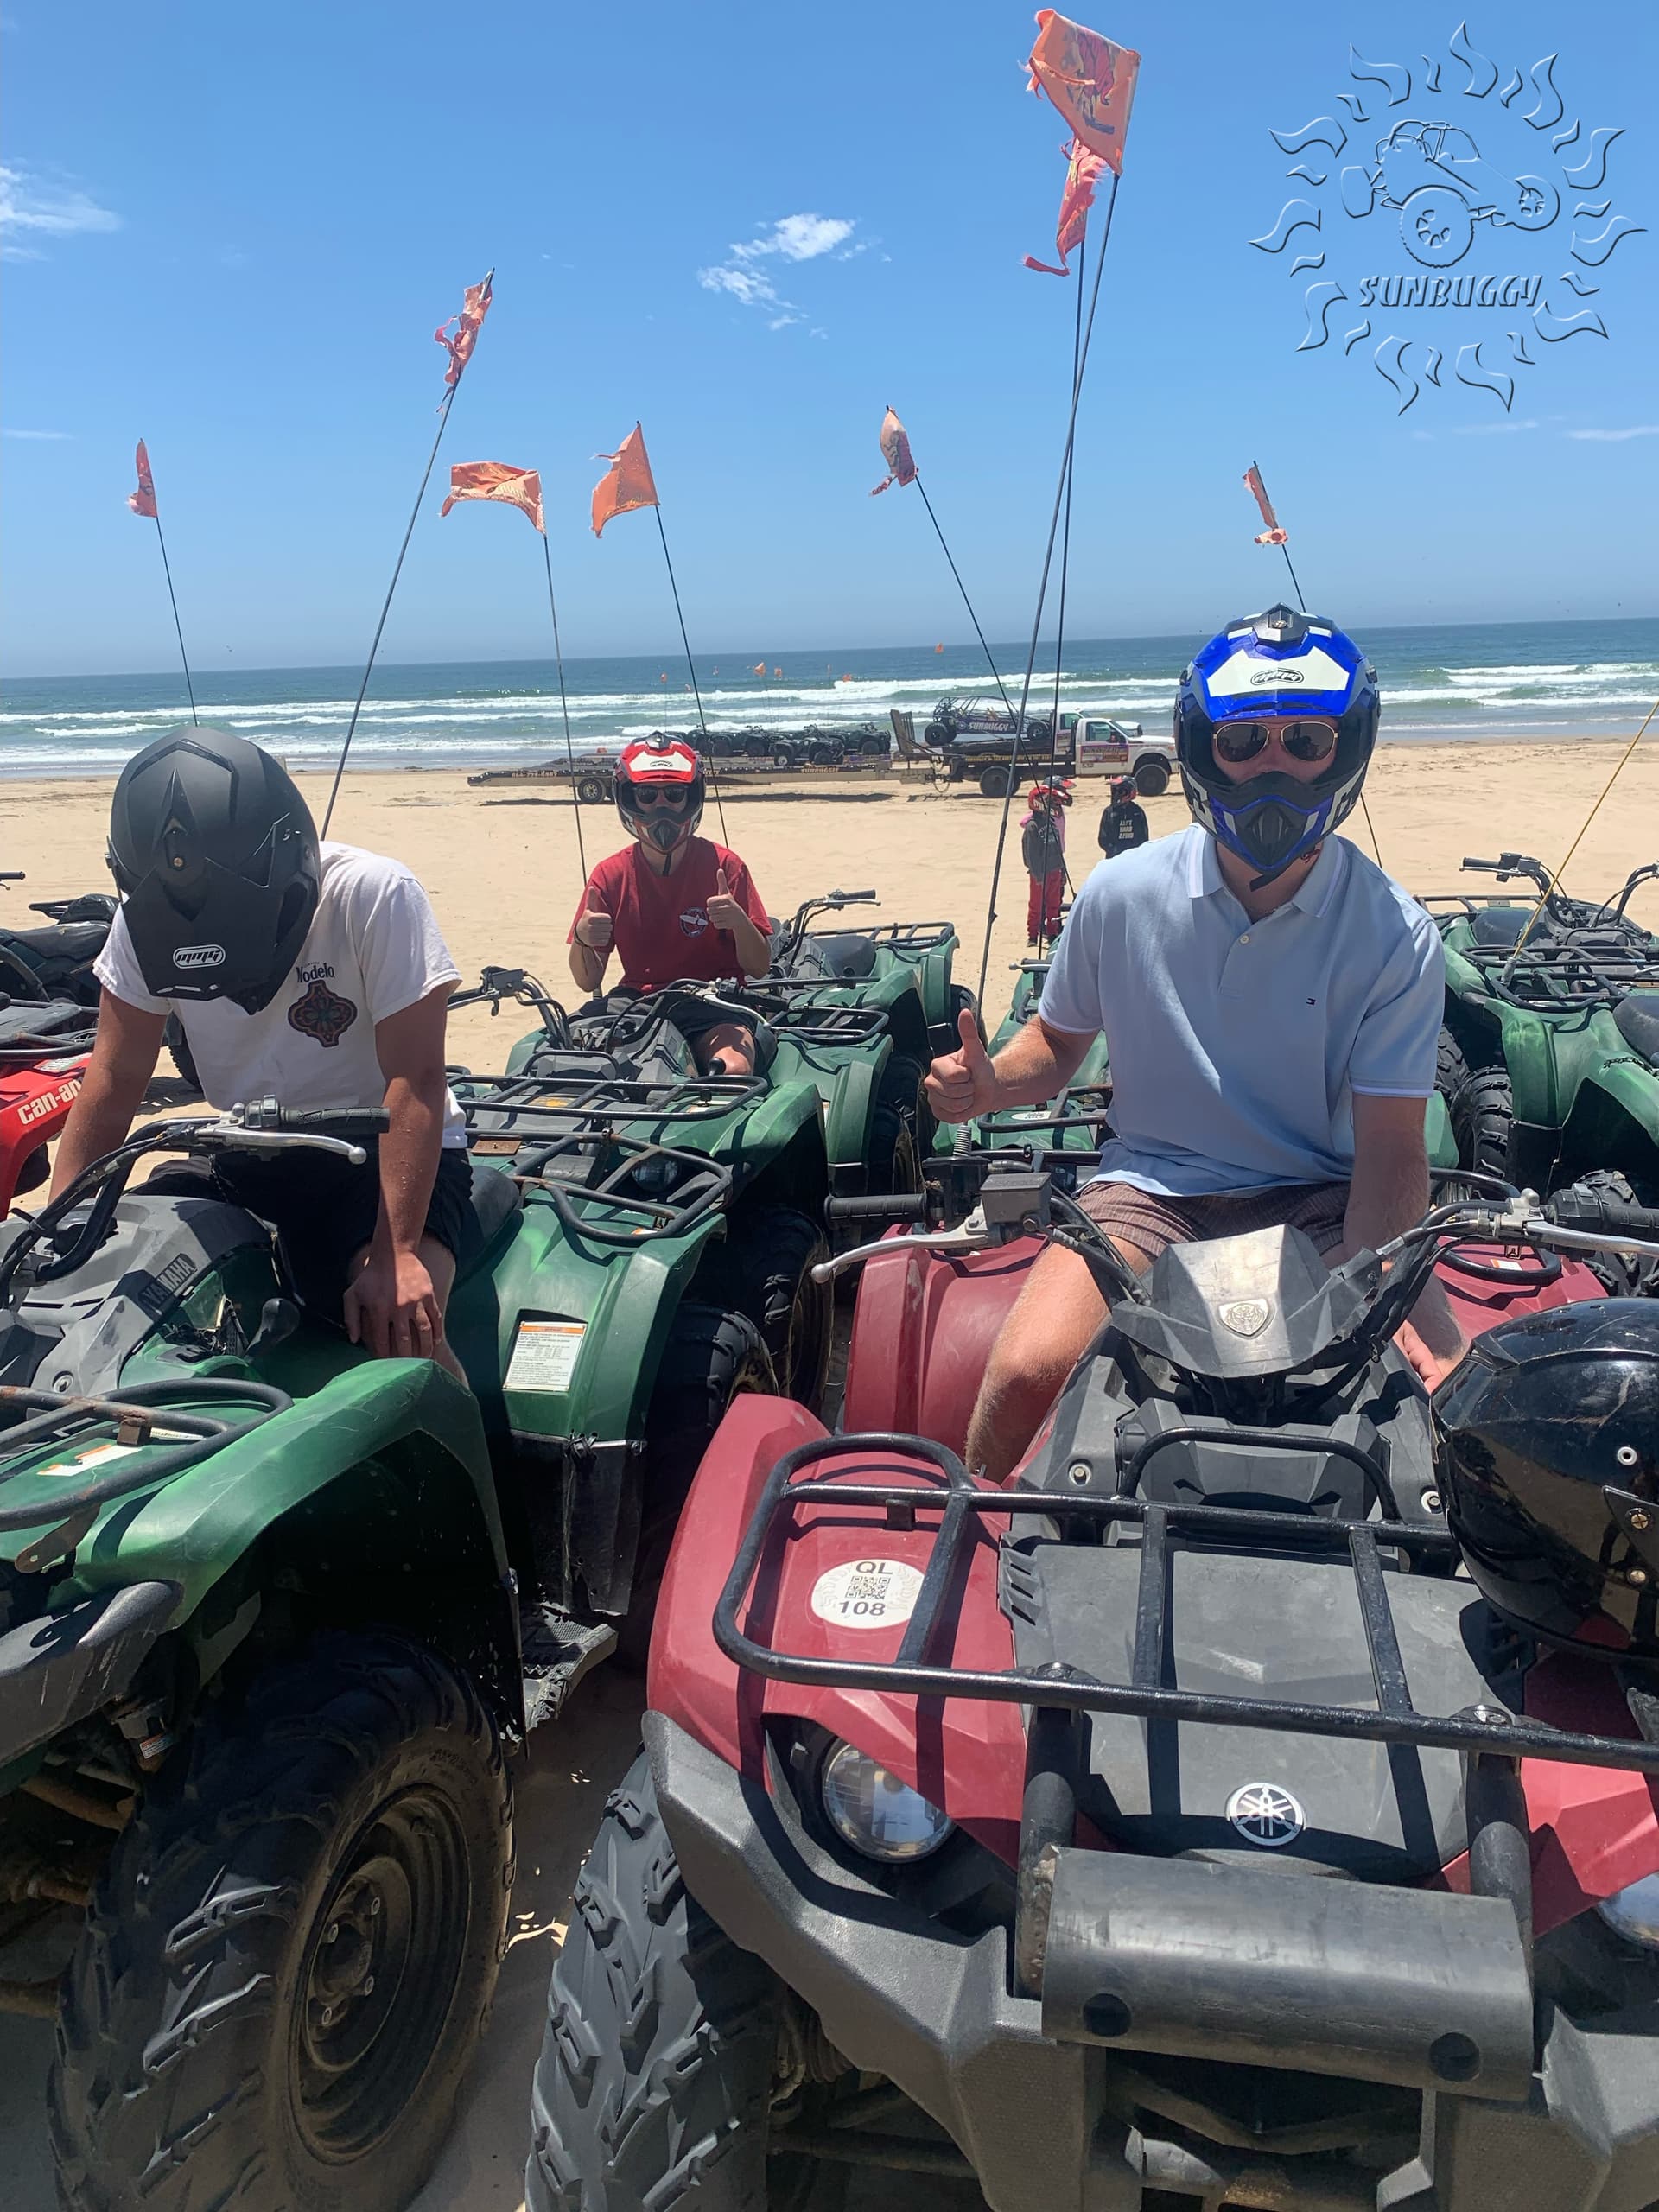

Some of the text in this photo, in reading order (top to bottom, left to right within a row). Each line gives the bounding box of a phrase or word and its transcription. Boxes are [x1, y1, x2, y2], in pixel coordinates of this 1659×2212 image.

[969, 721, 1009, 732] SUNBUGGY
[141, 1256, 194, 1305] YAMAHA
[855, 1561, 893, 1575] QL
[839, 1601, 885, 1616] 108
